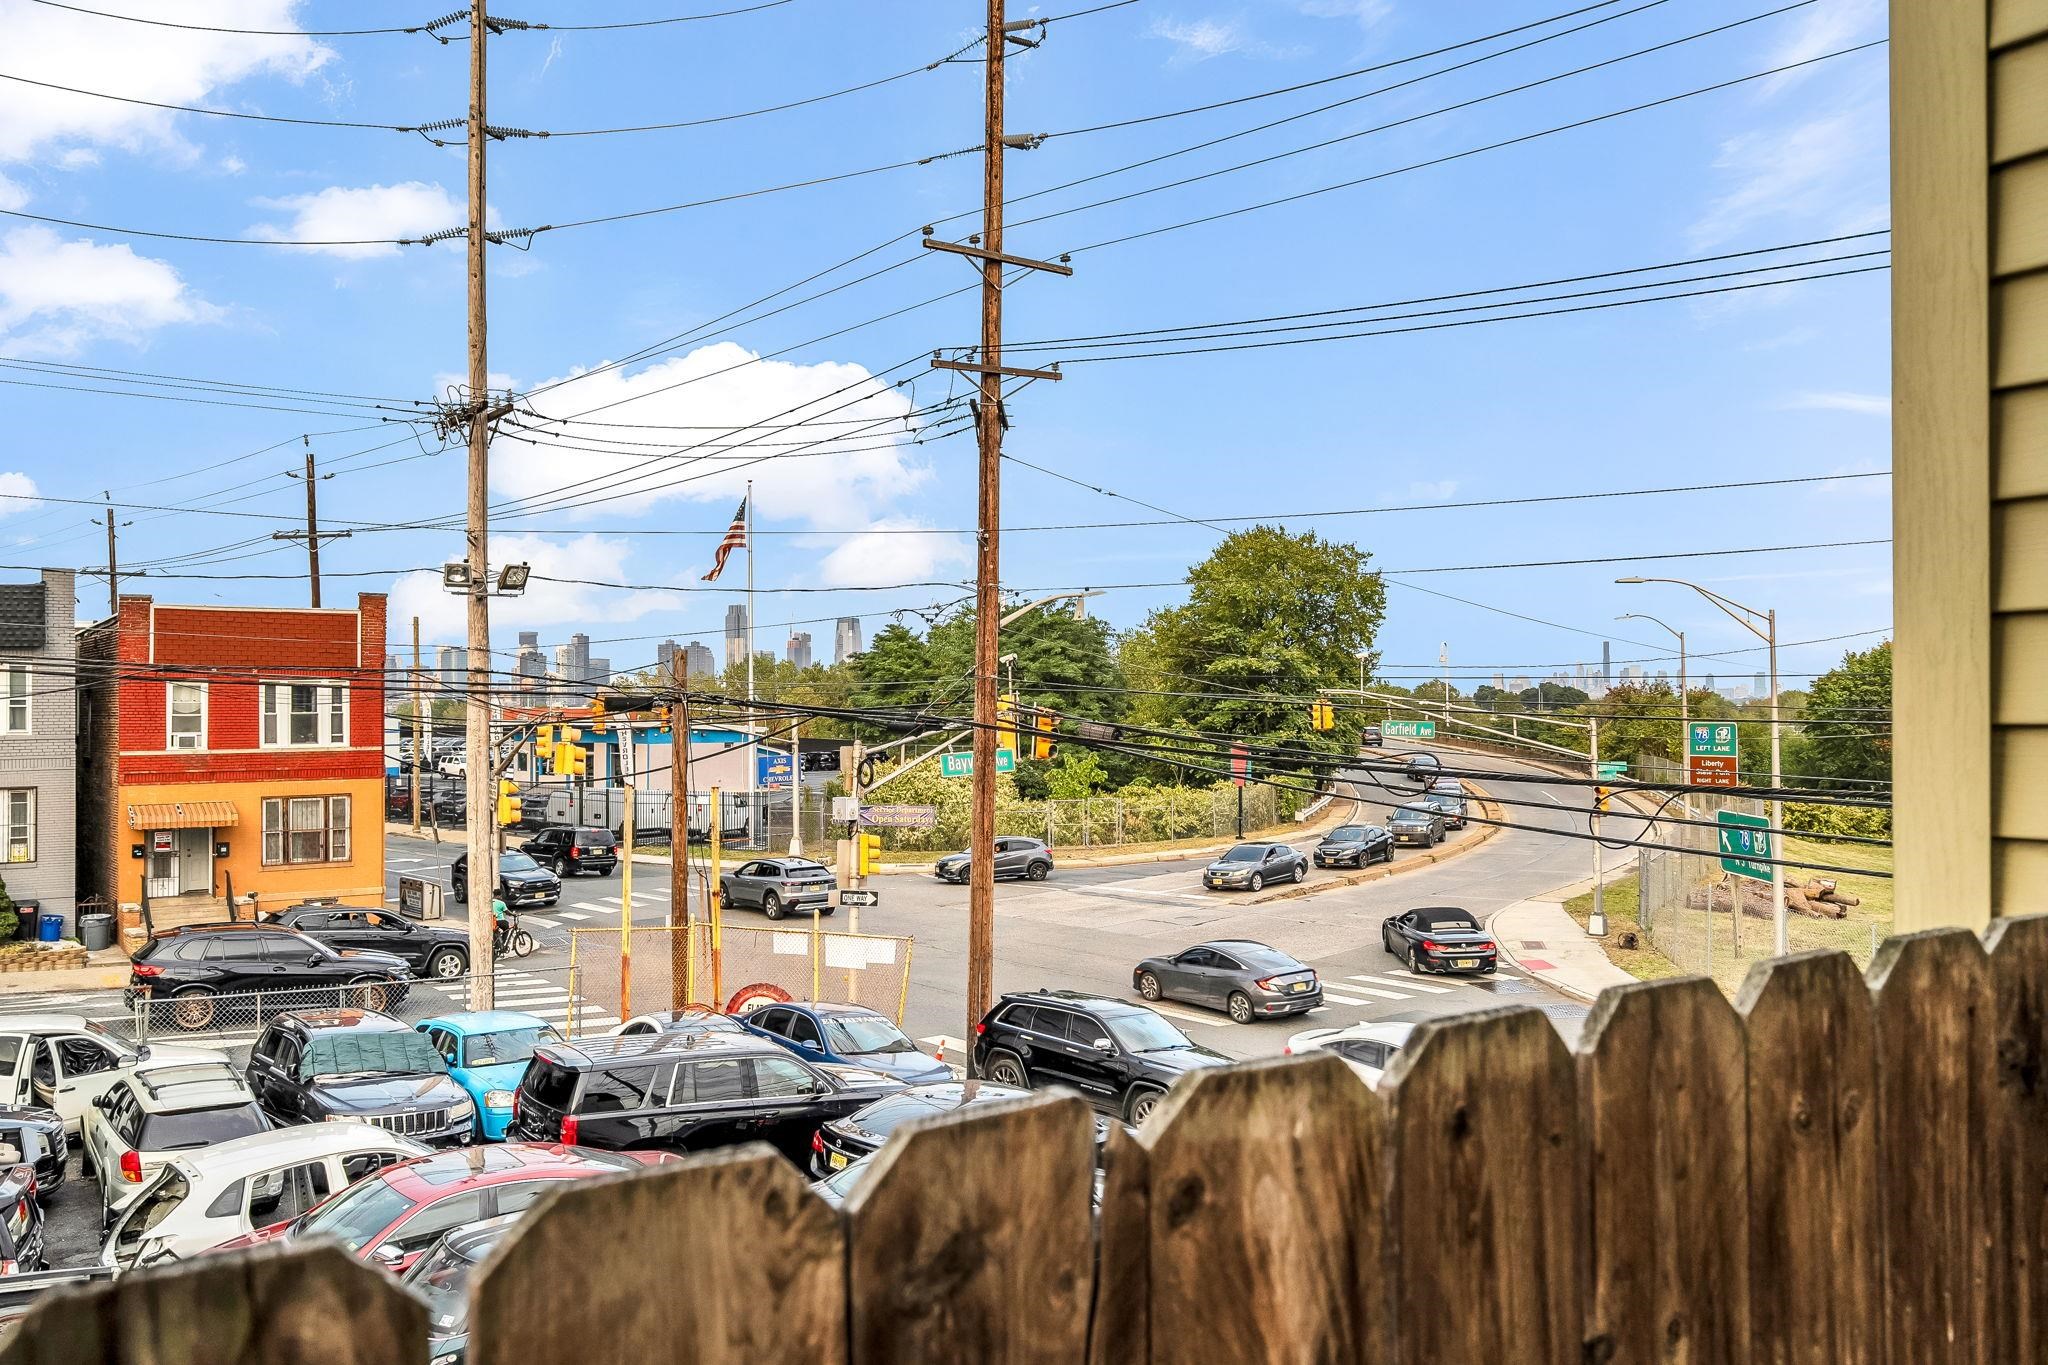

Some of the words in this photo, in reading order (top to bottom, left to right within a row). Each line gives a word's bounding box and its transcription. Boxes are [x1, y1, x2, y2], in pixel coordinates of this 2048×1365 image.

[1385, 722, 1417, 735] Garfield
[1420, 726, 1432, 736] Ave
[1696, 731, 1708, 739] 78
[948, 755, 974, 773] Bayv
[1701, 760, 1724, 768] Liberty
[873, 805, 895, 814] Service
[897, 805, 933, 814] Department
[871, 815, 893, 824] Open
[895, 815, 933, 825] Saturdays
[1740, 830, 1749, 846] 78
[843, 894, 855, 902] ONE
